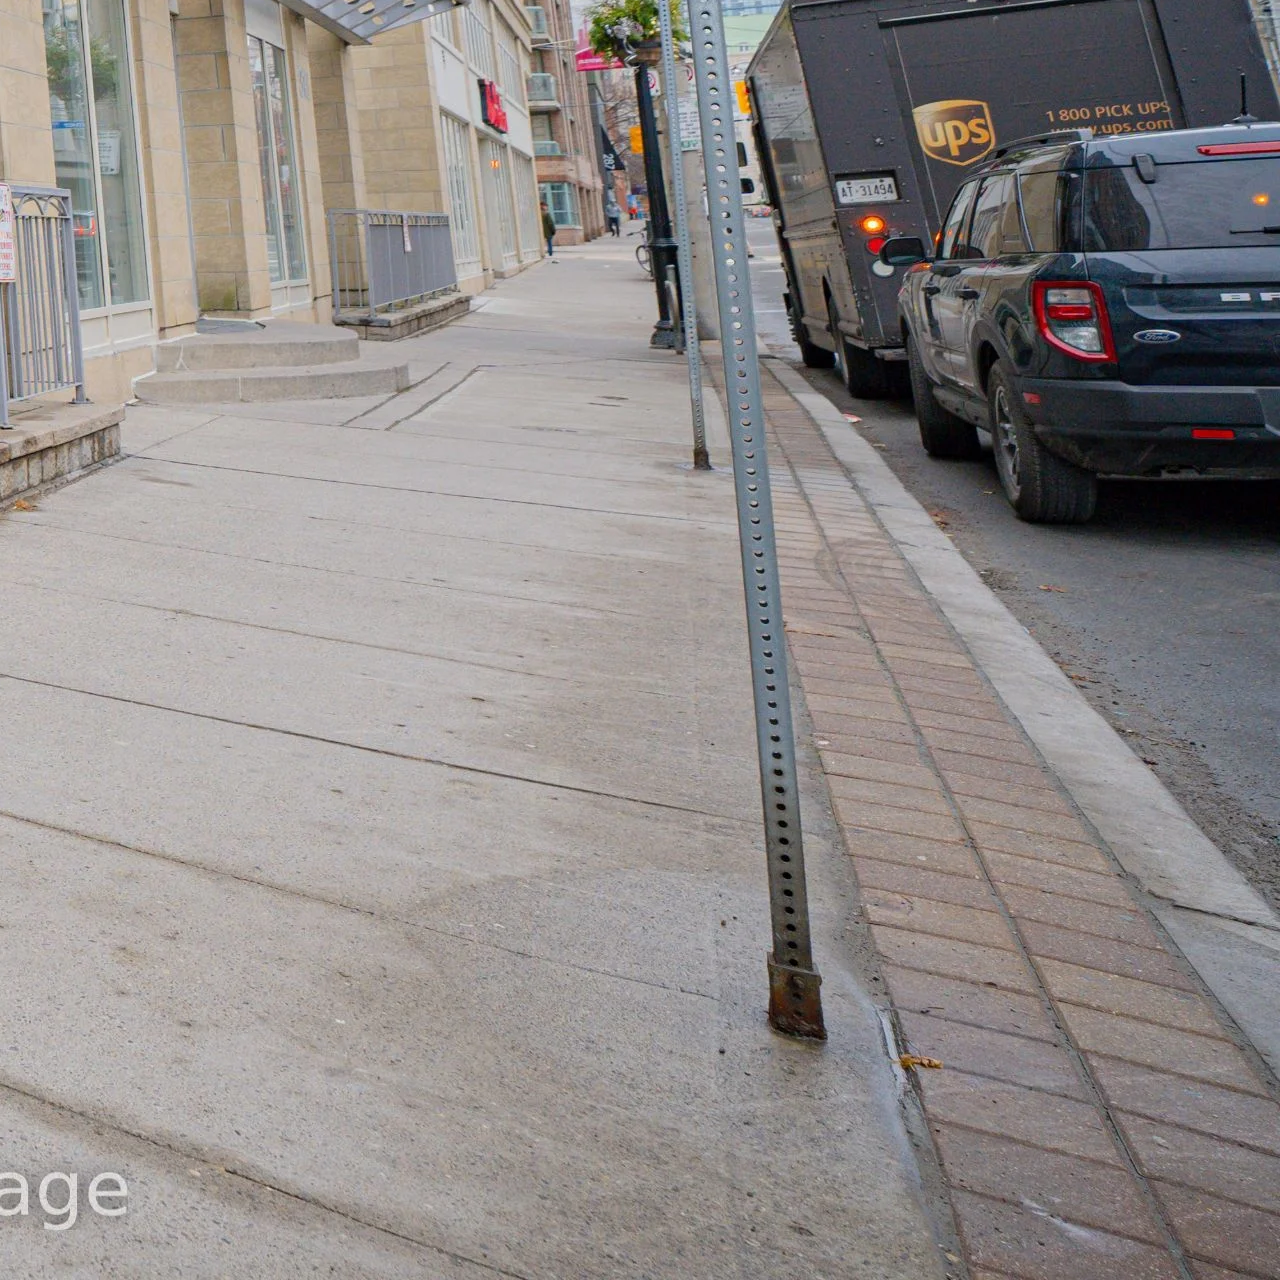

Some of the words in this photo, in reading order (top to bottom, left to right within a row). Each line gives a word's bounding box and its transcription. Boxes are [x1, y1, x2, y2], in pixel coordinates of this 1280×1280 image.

[1046, 110, 1055, 122] 1
[1059, 107, 1091, 122] 800
[1095, 104, 1134, 119] PICK
[1137, 101, 1171, 115] UPS
[921, 117, 990, 157] ups
